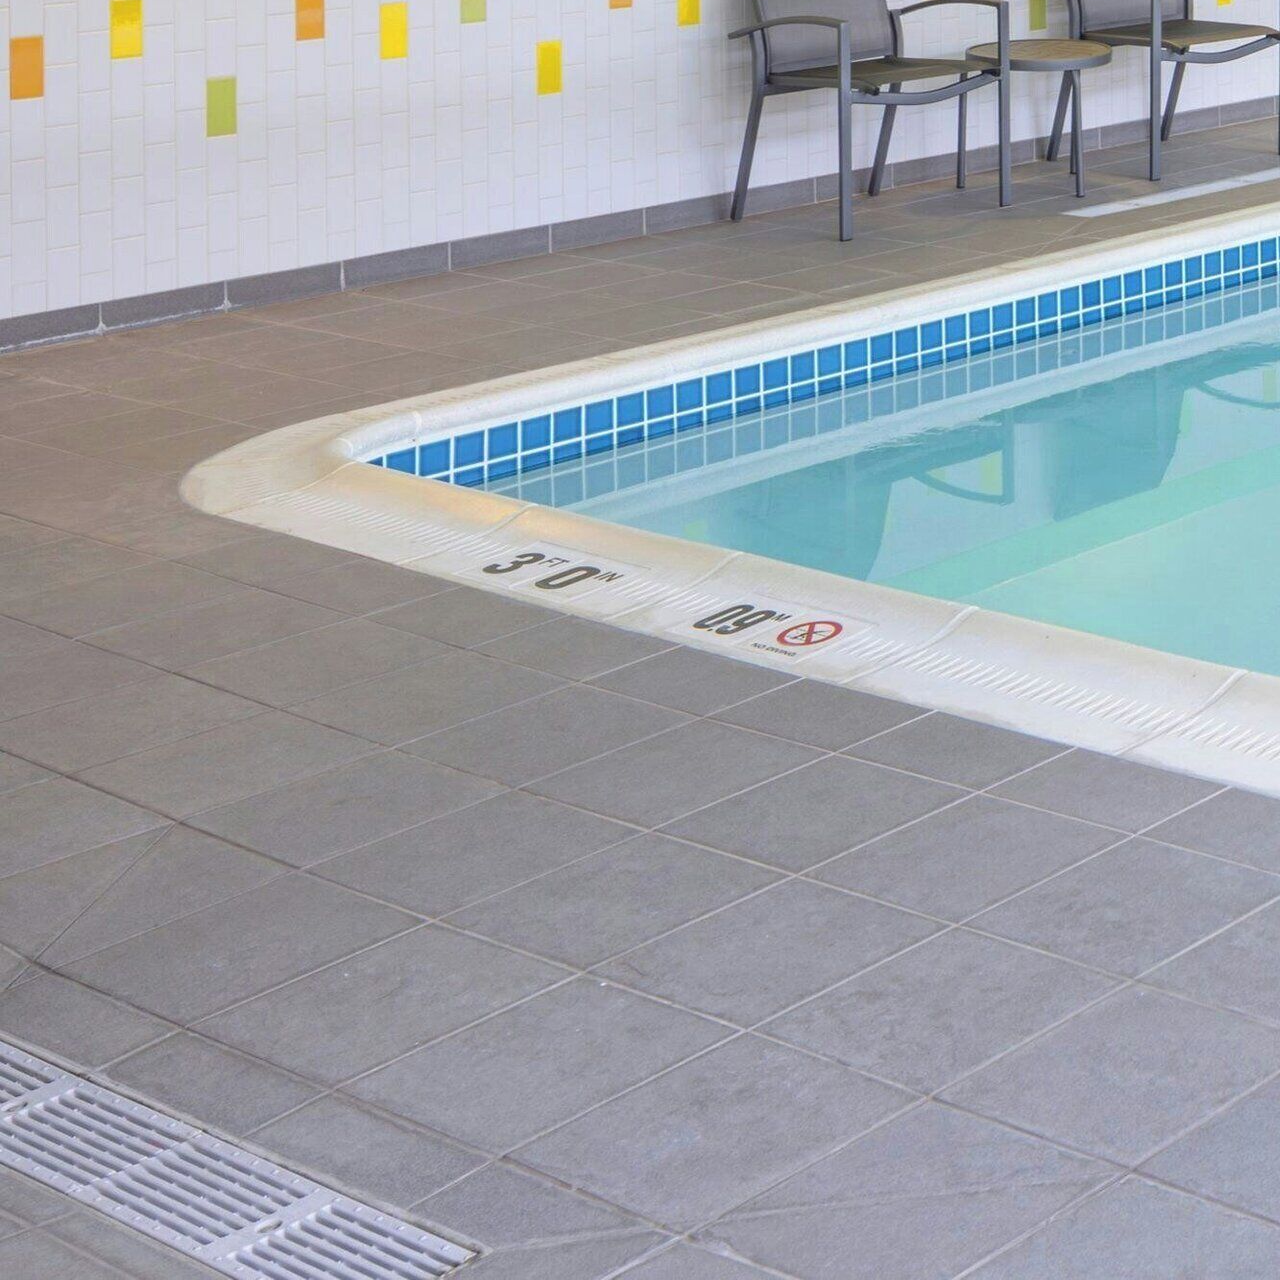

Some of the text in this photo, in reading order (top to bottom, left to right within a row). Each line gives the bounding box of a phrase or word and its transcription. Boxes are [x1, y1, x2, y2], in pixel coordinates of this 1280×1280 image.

[482, 552, 546, 575] 3
[538, 557, 570, 568] FT
[535, 566, 601, 590] 0
